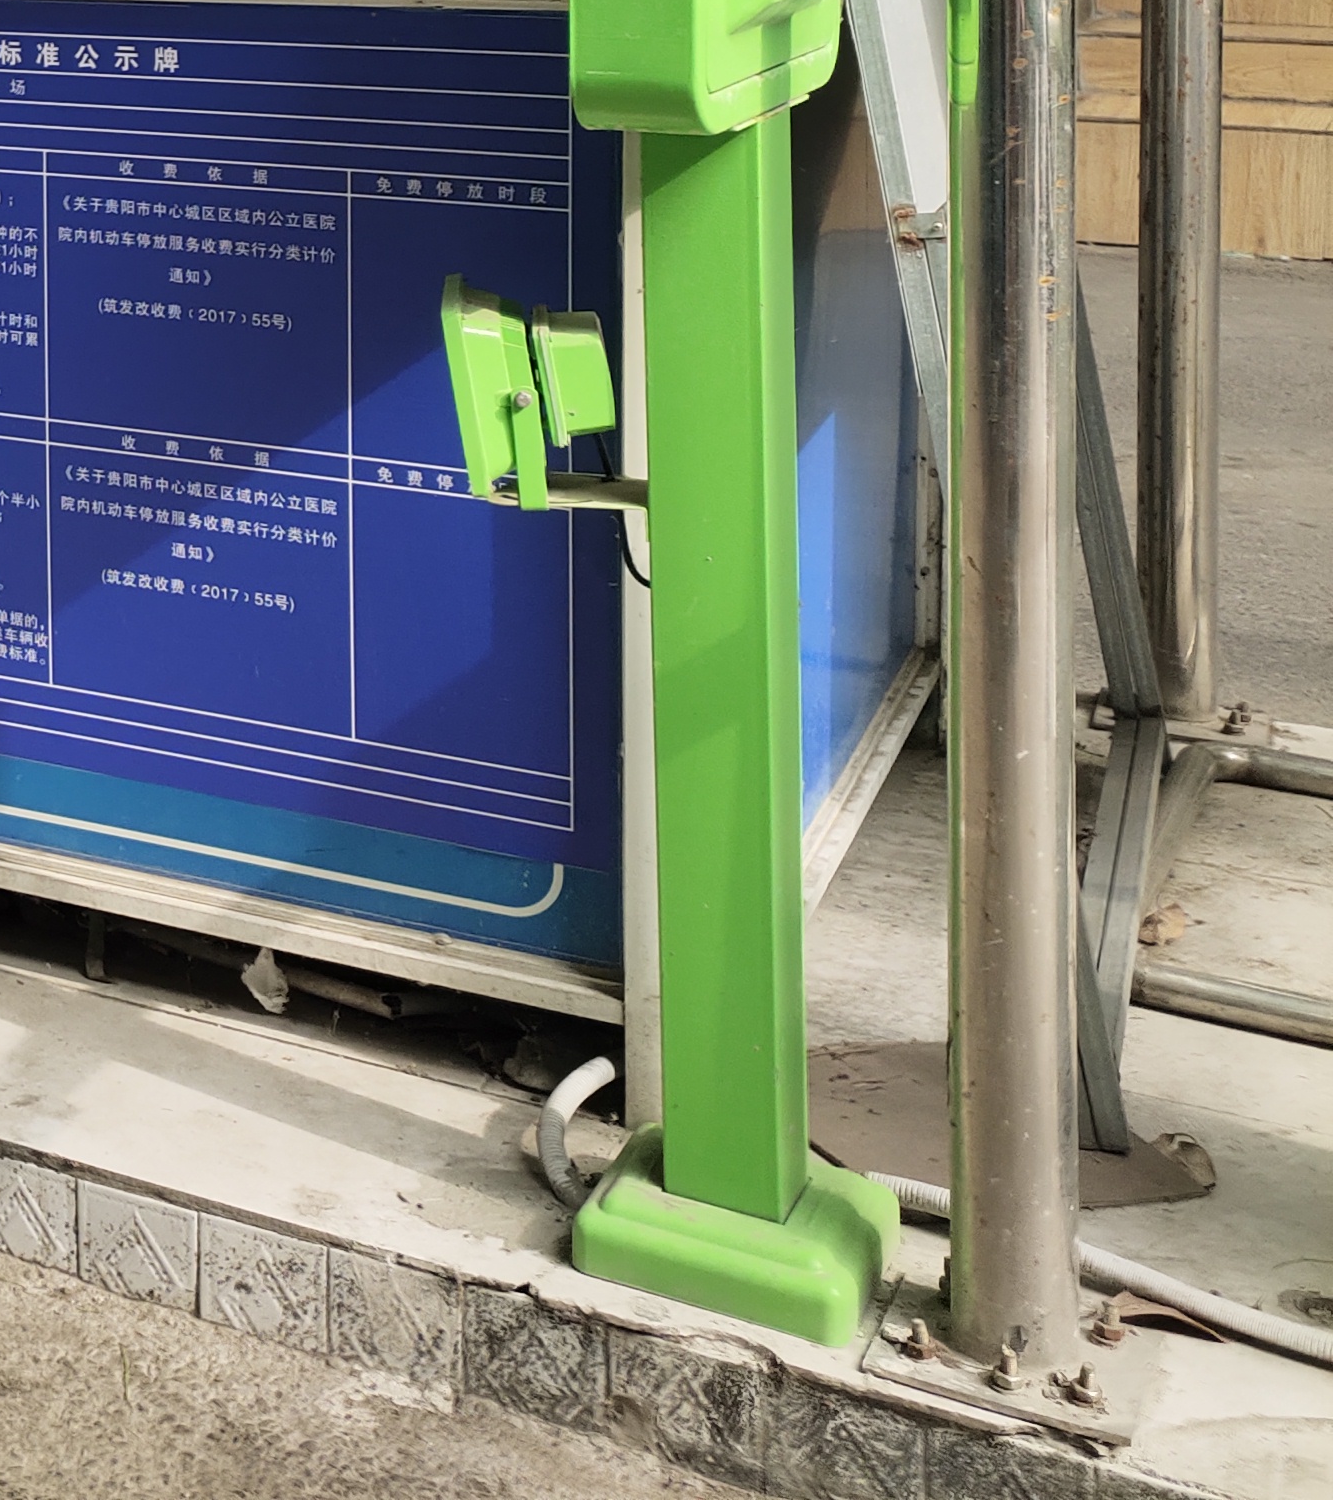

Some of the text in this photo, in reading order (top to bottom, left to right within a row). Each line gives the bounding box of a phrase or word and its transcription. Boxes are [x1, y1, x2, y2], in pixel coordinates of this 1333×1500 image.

[119, 159, 268, 185] 收费依据
[376, 176, 548, 205] 免费停放时段
[62, 194, 336, 231] 《关于贵阳市中心城区区域内公立医院
[58, 226, 336, 264] 院内机动车停放服务收费实行分类计价
[169, 267, 212, 286] 通知》
[121, 435, 270, 468] 收费依据
[64, 465, 337, 516] 《关于贵阳市中心城区区域内公立医院
[60, 496, 337, 548] 院内机动车停放服务收费实行分类计价
[171, 542, 214, 563] 通知》
